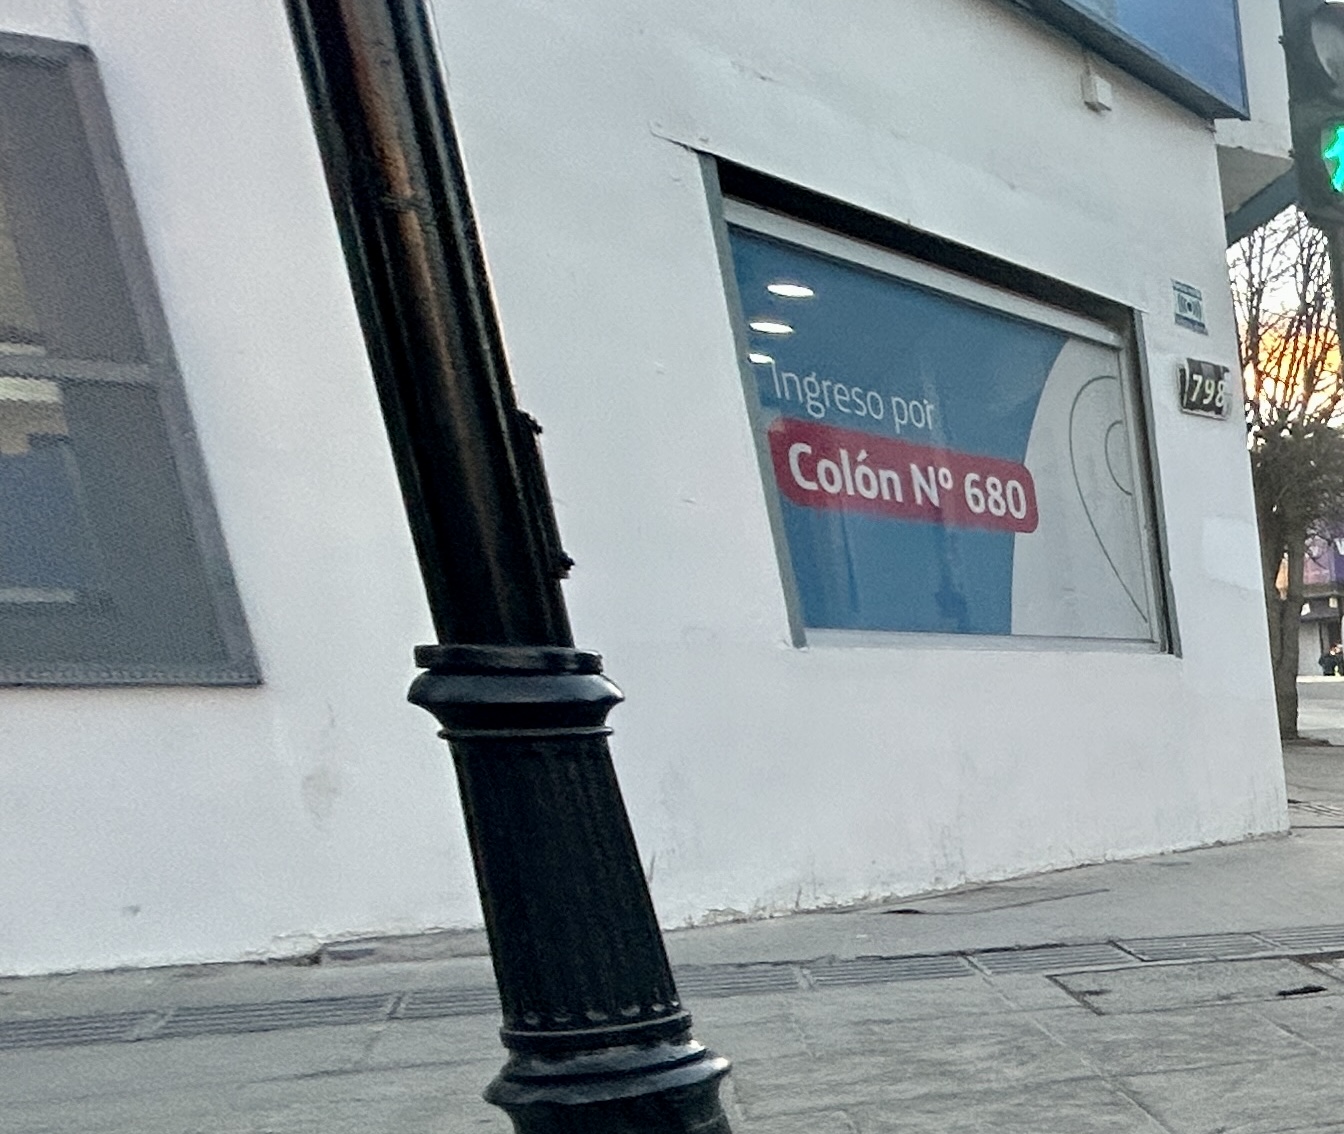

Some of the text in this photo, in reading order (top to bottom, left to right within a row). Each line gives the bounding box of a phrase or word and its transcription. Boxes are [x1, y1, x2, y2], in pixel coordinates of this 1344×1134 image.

[771, 360, 936, 434] Ingreso por
[1189, 373, 1227, 408] 798
[787, 442, 904, 504] Colón
[963, 472, 1028, 521] 680
